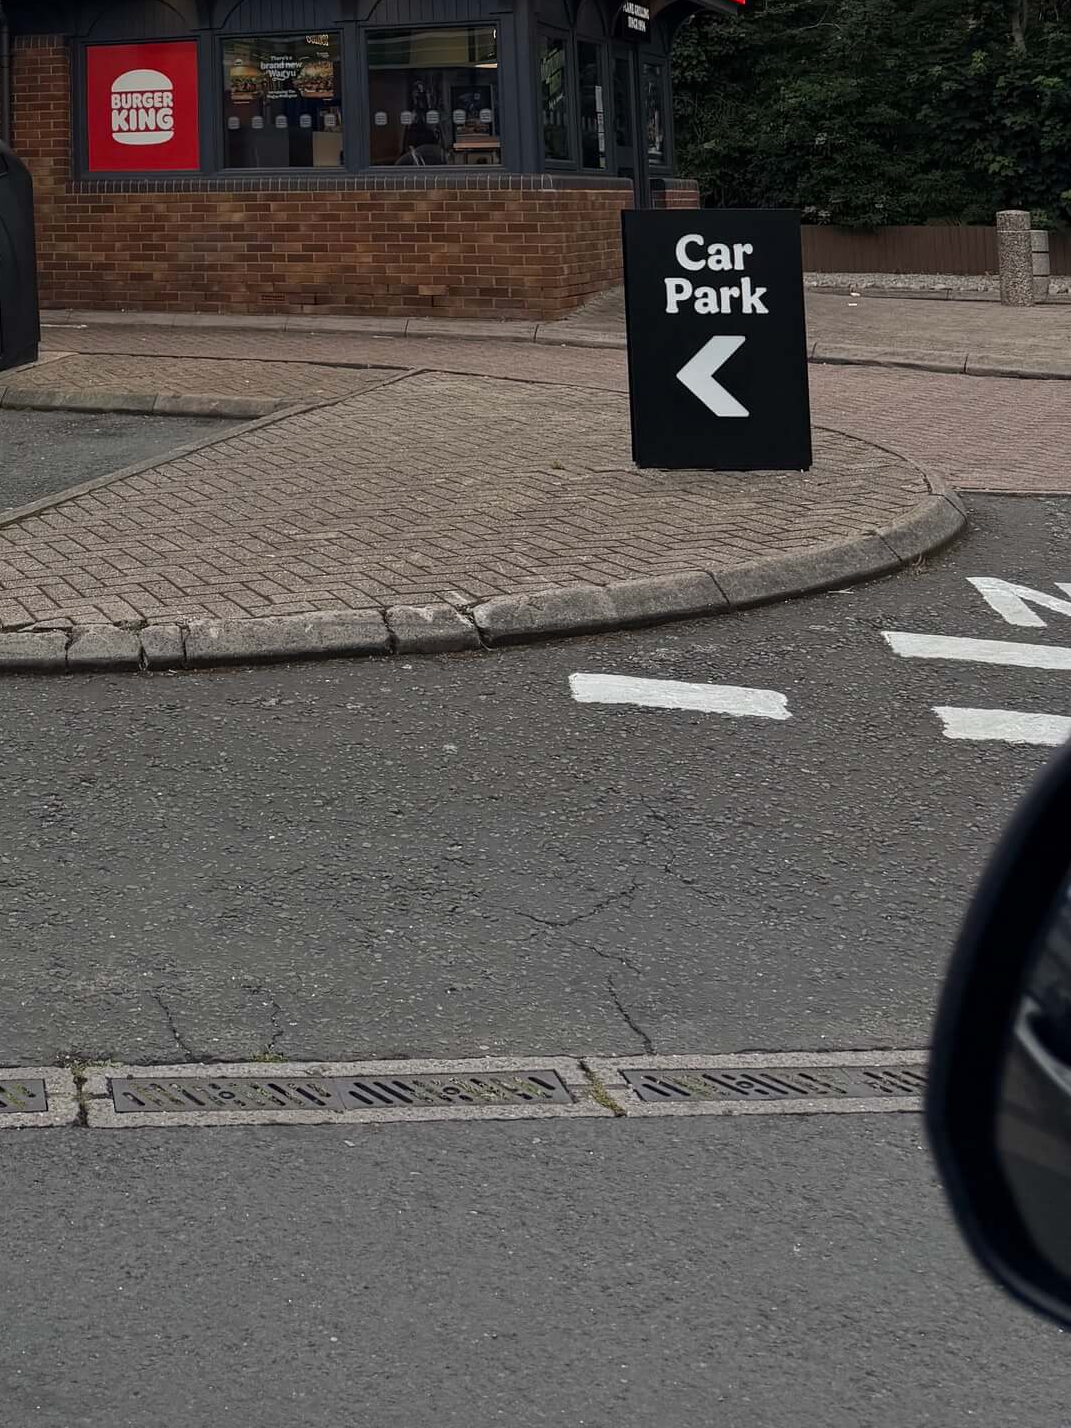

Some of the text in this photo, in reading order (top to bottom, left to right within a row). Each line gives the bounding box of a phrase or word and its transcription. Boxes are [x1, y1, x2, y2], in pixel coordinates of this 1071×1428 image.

[260, 59, 303, 69] brand new
[111, 91, 174, 109] BURGER
[111, 107, 174, 132] KING
[675, 233, 754, 271] Car
[664, 276, 770, 314] Park
